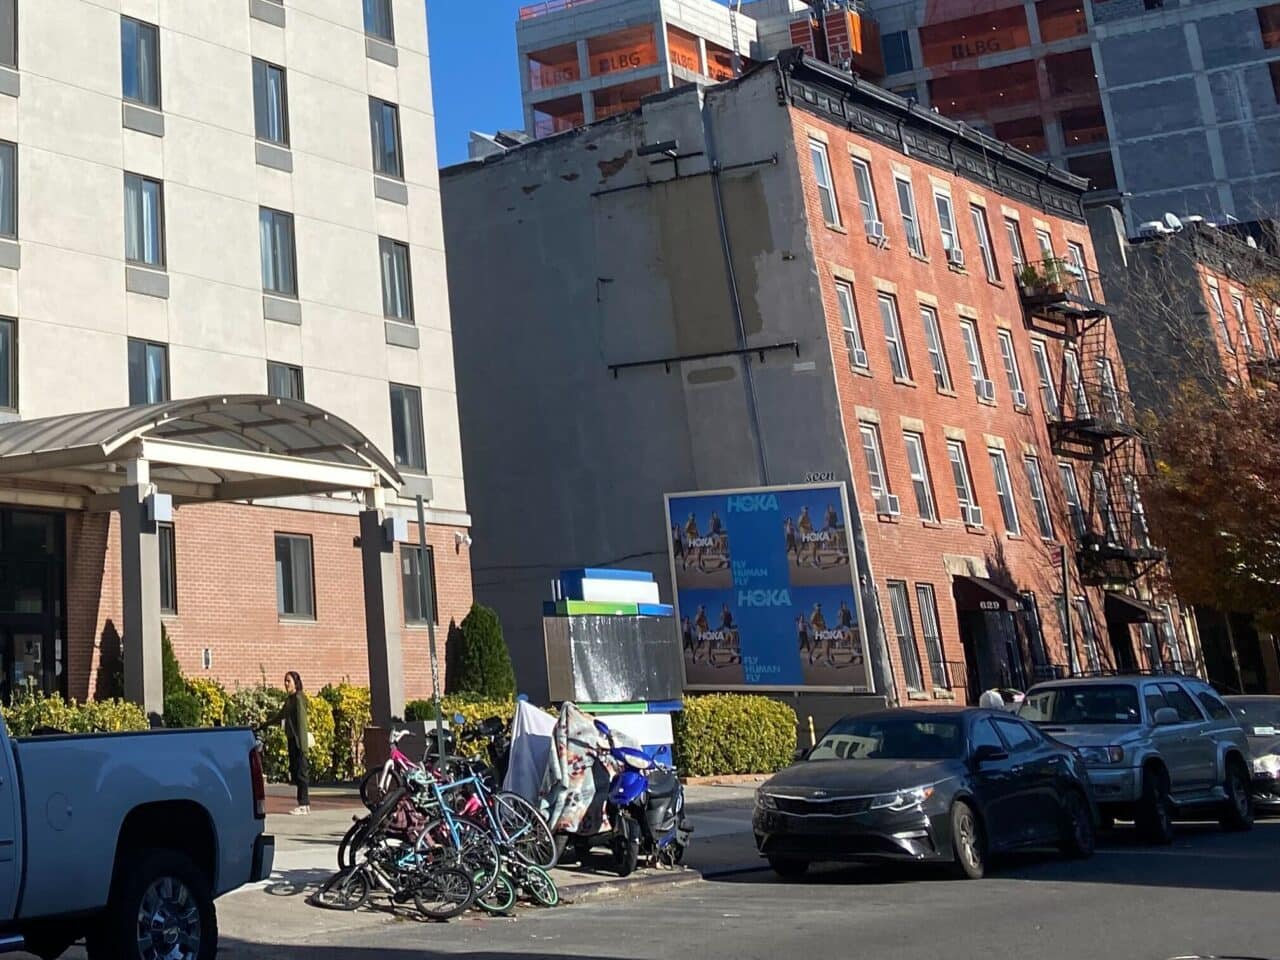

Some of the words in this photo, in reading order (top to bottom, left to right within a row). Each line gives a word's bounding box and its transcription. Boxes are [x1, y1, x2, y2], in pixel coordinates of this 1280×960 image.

[966, 39, 1000, 56] LBG
[610, 51, 640, 70] LBG
[805, 471, 835, 482] seen
[727, 494, 779, 512] HOKA
[688, 537, 714, 547] HOKA
[802, 532, 830, 542] HOKA
[733, 560, 747, 568] FLY
[733, 568, 768, 577] HUMAN
[734, 577, 749, 586] FLY
[738, 589, 792, 607] HOKA
[698, 631, 725, 641] HOKA
[815, 631, 843, 641] HOKA
[743, 656, 758, 664] FLY
[744, 665, 781, 673] HUMAN
[745, 673, 760, 682] FLY
